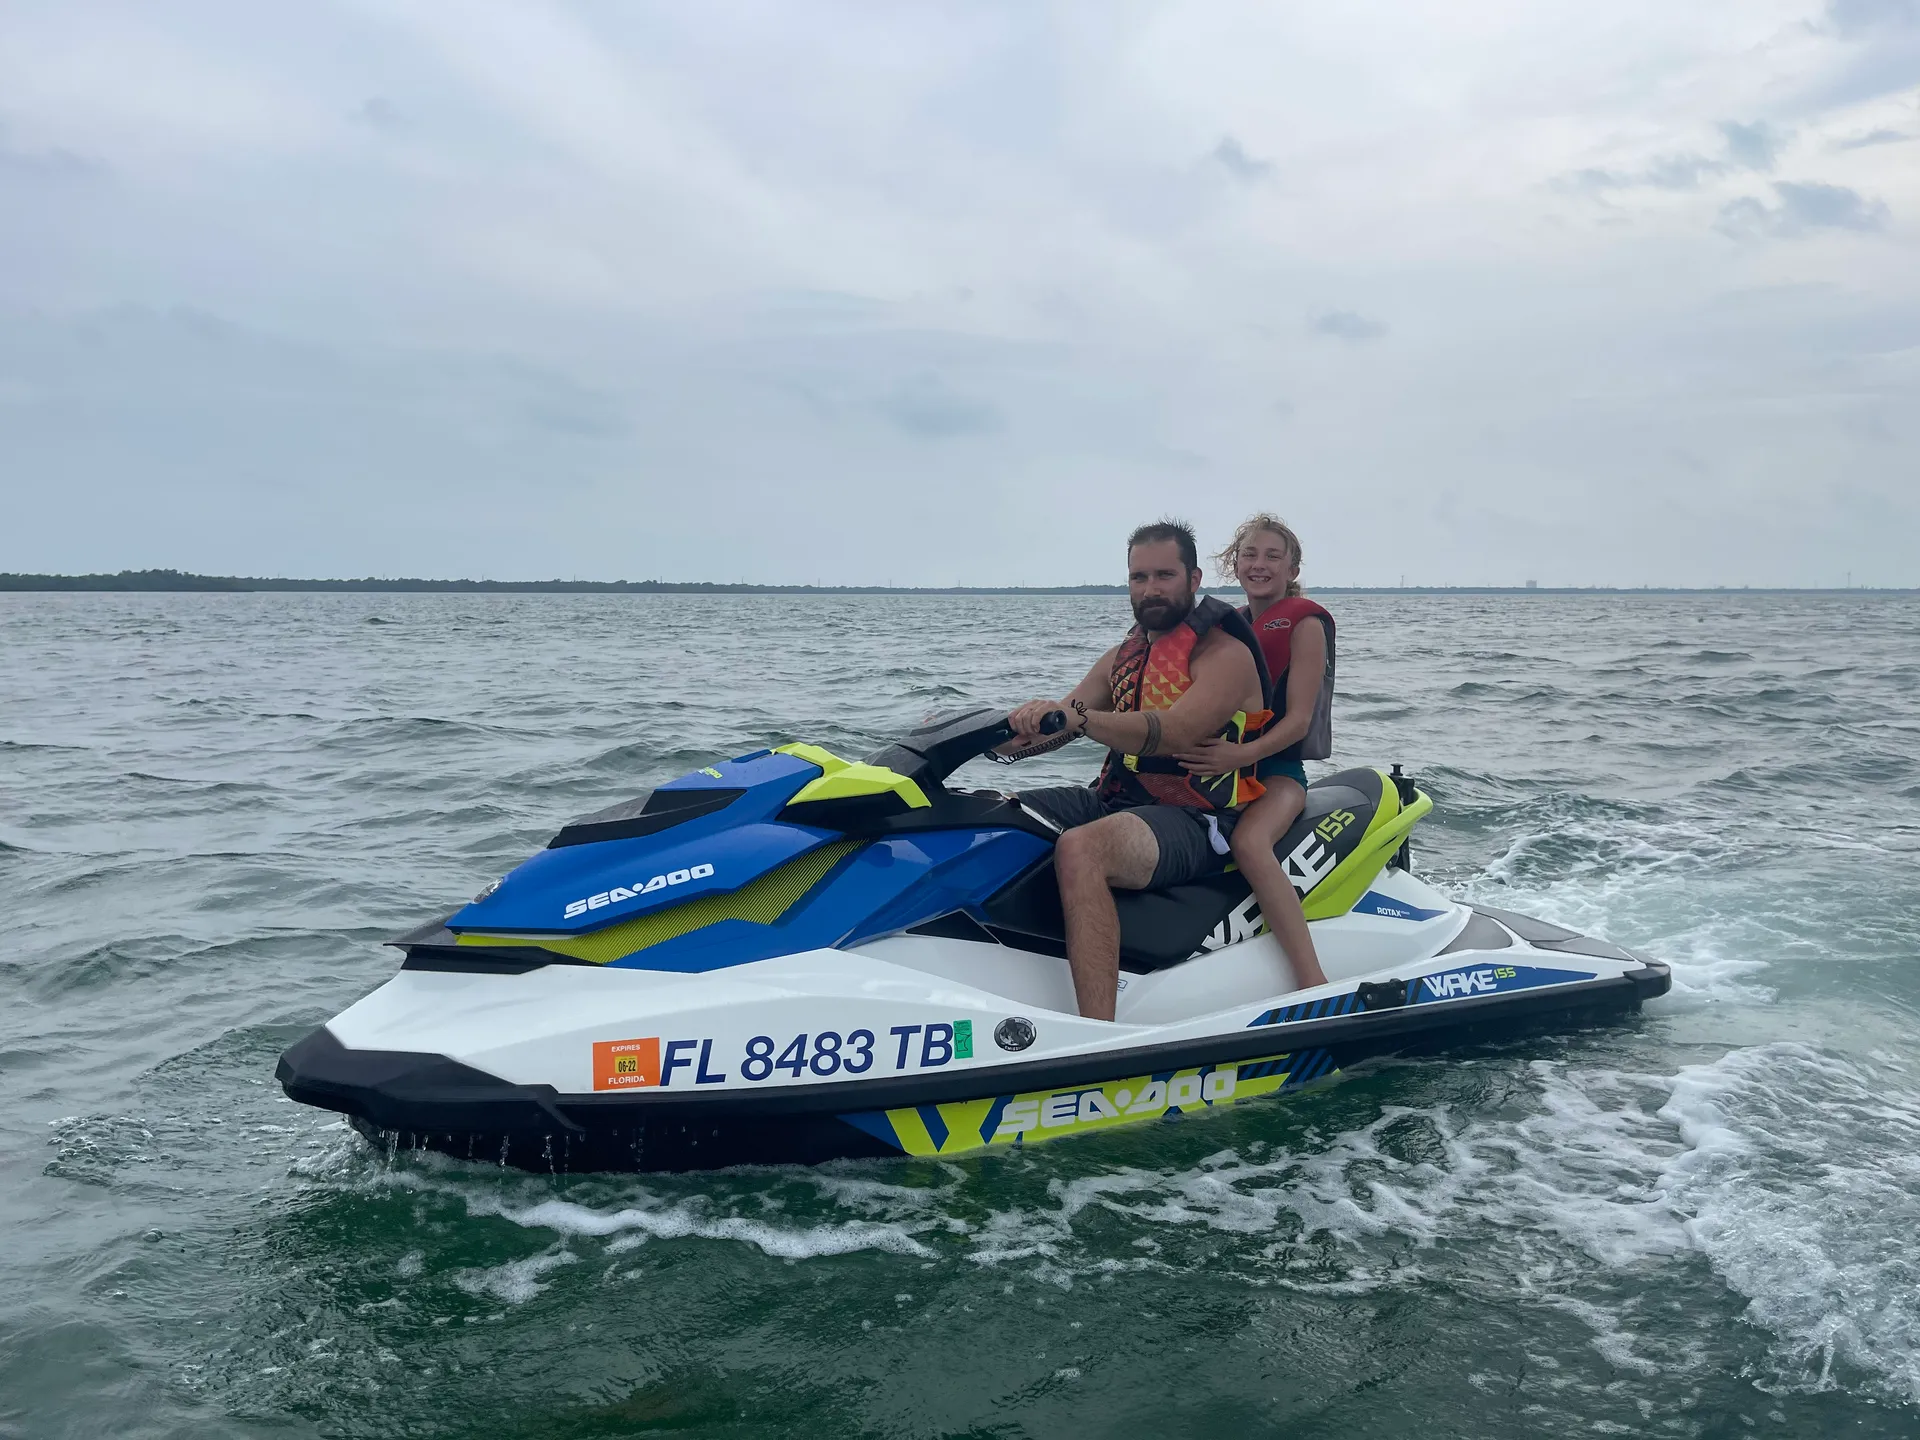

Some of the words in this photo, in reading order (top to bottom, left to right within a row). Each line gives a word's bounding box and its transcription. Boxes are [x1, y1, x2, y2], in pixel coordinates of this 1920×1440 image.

[1315, 808, 1356, 843] 155
[1376, 906, 1402, 918] ROTAX
[1422, 969, 1498, 998] WAKE
[1493, 967, 1517, 980] 155
[611, 1044, 641, 1053] EXPIRES
[659, 1038, 727, 1087] FL
[740, 1028, 875, 1082] 8483
[889, 1023, 954, 1070] TB
[618, 1060, 636, 1073] 06-22
[608, 1075, 645, 1085] FLORIDA
